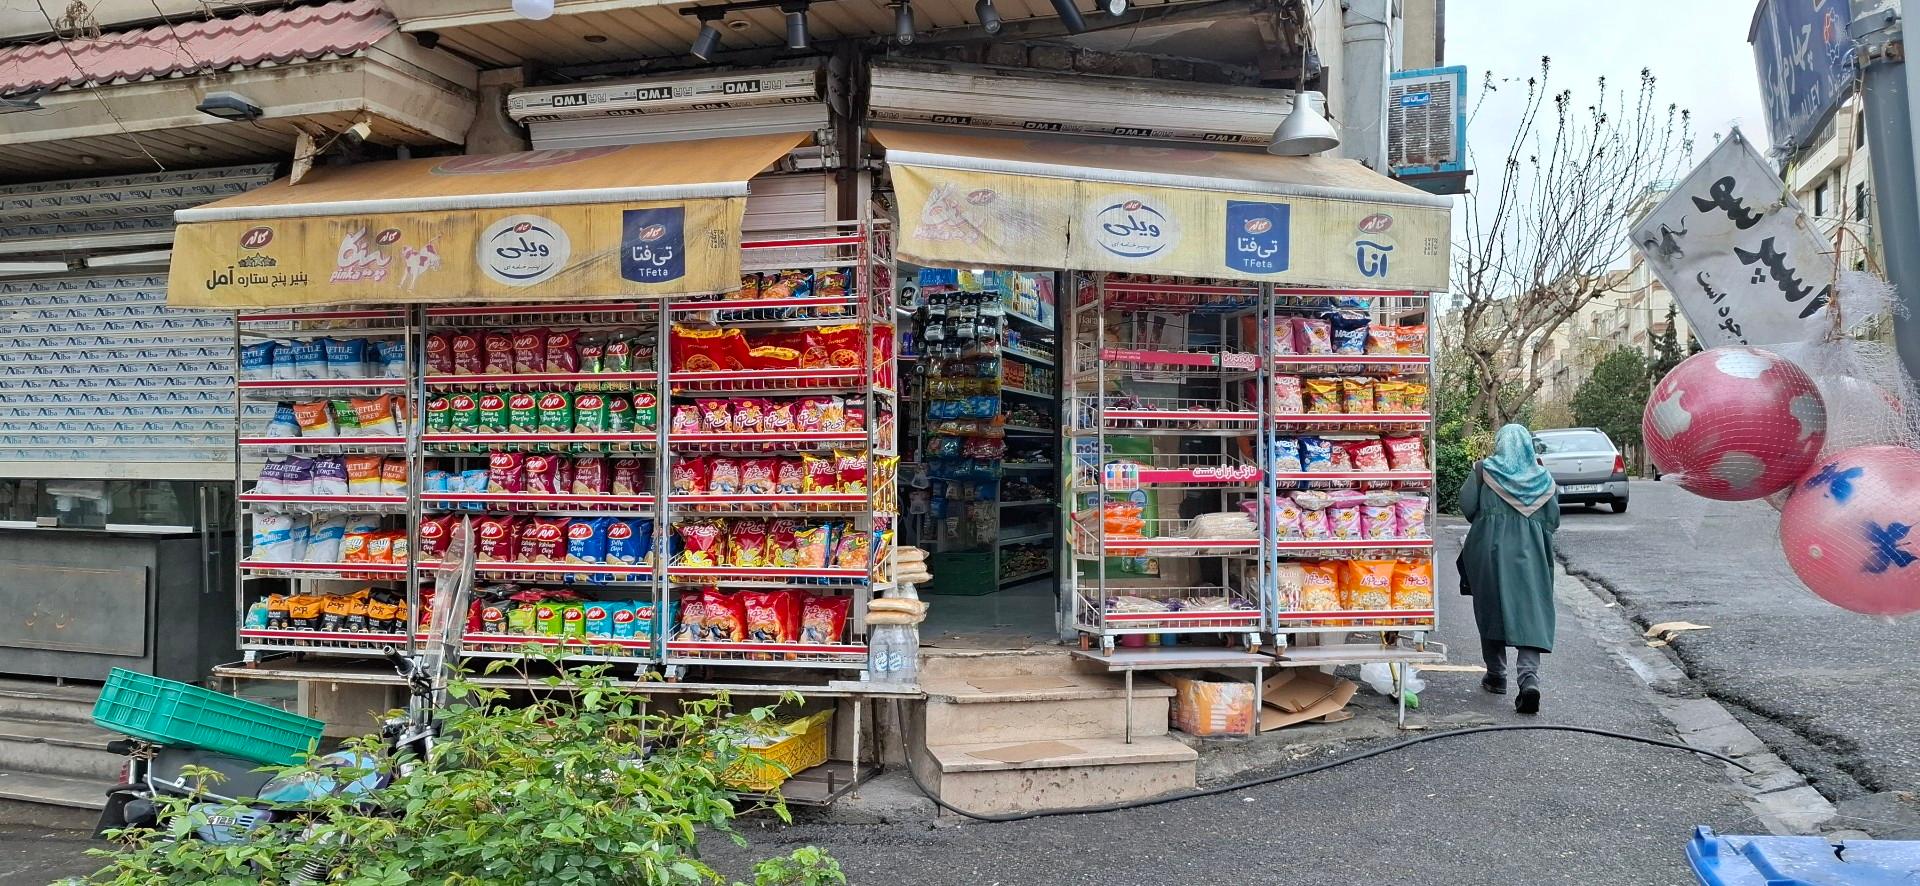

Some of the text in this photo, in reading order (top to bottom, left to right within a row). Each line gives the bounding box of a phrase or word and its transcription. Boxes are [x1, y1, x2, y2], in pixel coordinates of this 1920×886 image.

[638, 87, 672, 99] TWO
[725, 81, 759, 93] TWO
[553, 96, 586, 107] TWO
[935, 115, 969, 124] TWO
[1026, 121, 1060, 131] TWO
[1115, 127, 1150, 137] TWO
[1205, 134, 1239, 143] TWO
[1103, 214, 1161, 238] ویلی
[496, 236, 550, 259] ویلی
[206, 265, 308, 290] پنیر پنج ستاره آمل
[1696, 270, 1728, 305] است
[5, 361, 229, 375] Alba Alba Alba Alba Alba Alba Alba Alba
[21, 376, 217, 389] Alba Alba Alba Alba Alba Alba Alba
